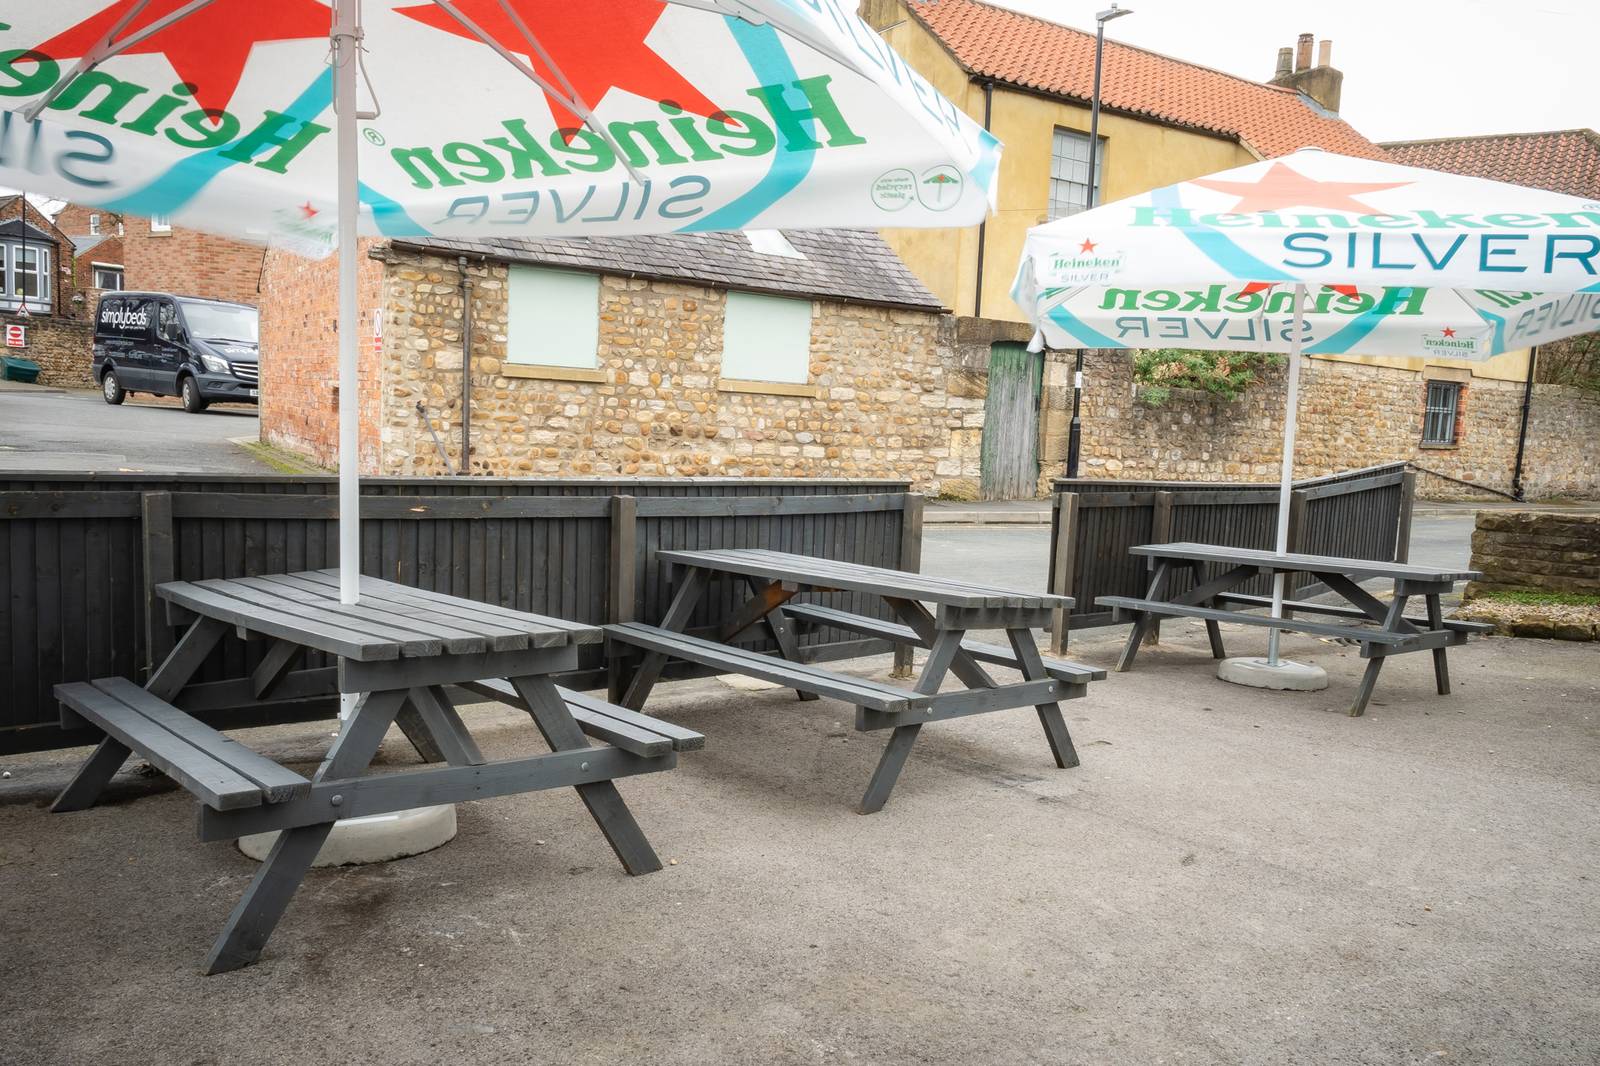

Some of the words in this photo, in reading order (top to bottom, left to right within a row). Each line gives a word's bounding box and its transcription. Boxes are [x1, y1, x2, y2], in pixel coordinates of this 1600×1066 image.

[1127, 206, 1600, 230] Heineken
[1054, 257, 1120, 269] Heineken
[1282, 232, 1600, 275] SILVER
[101, 307, 147, 329] simplybeds
